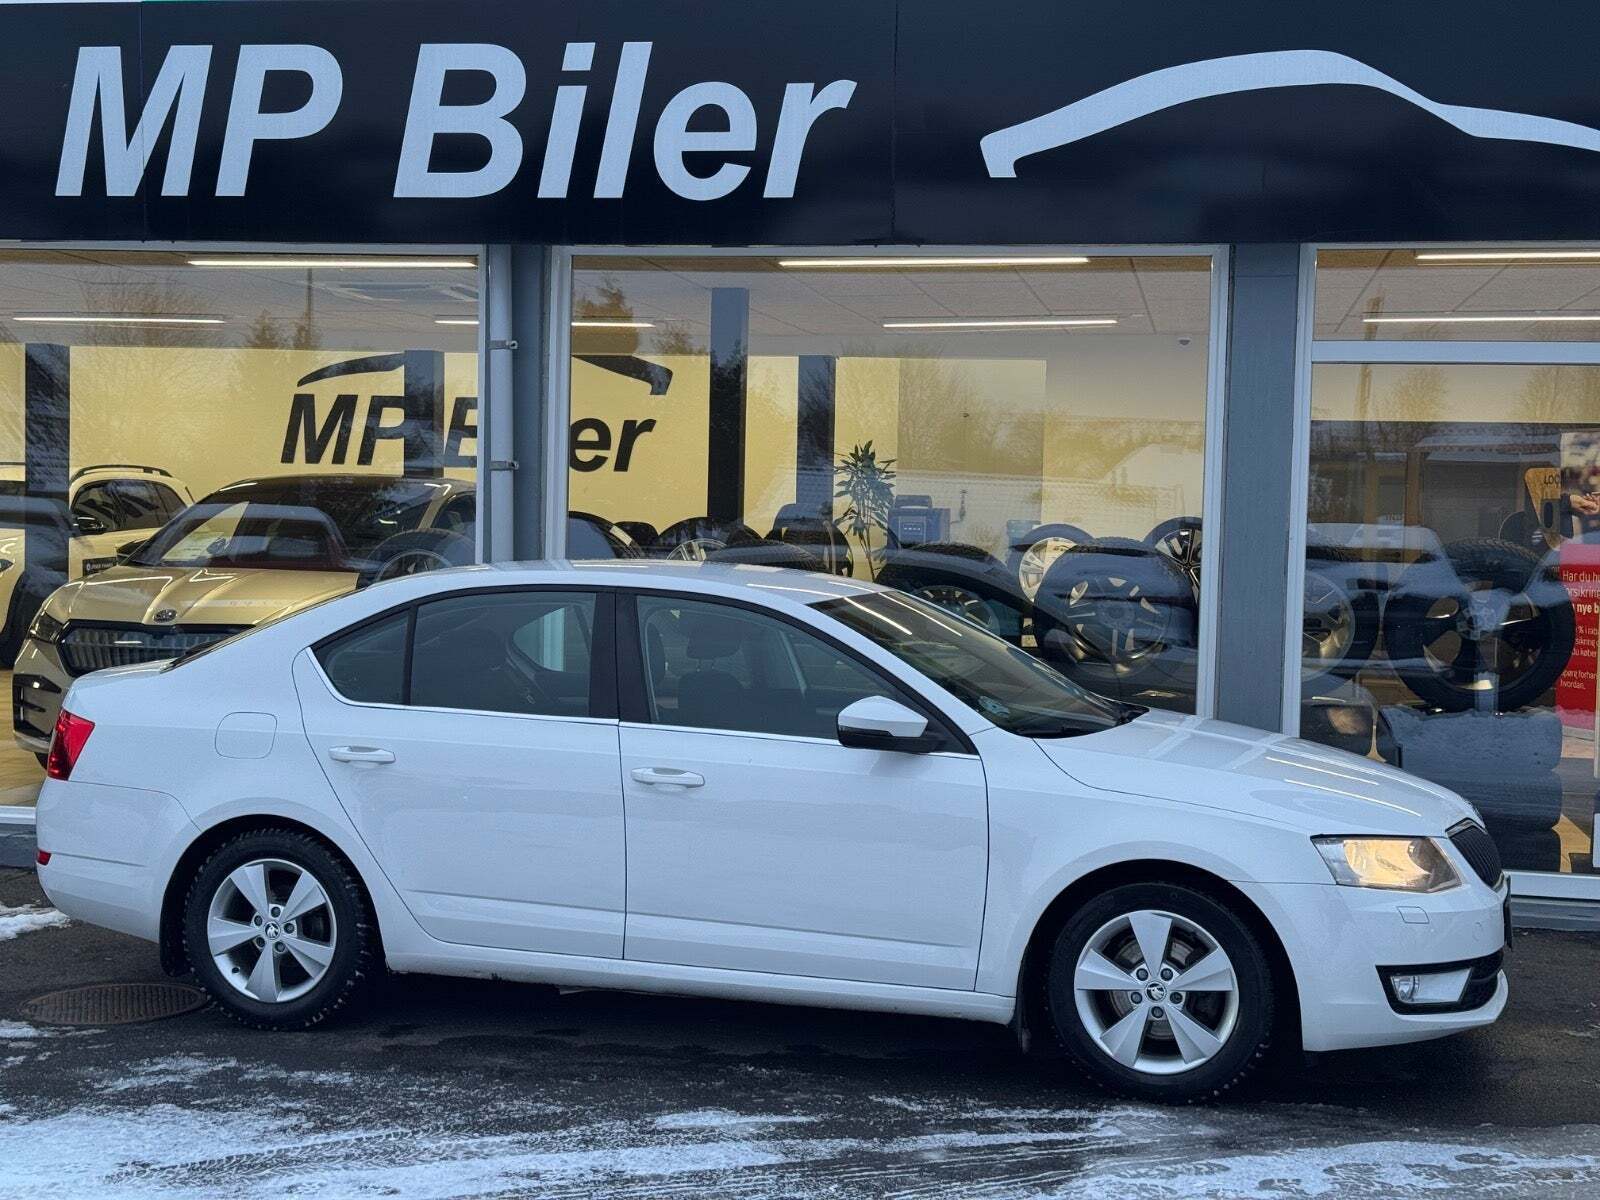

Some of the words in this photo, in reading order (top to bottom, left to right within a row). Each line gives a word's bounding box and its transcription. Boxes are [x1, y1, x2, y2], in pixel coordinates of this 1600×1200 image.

[55, 44, 344, 196] MP
[393, 41, 858, 201] Biler
[281, 393, 415, 466] MP
[1562, 570, 1578, 582] Har
[1579, 571, 1591, 584] du
[1576, 603, 1592, 615] nye
